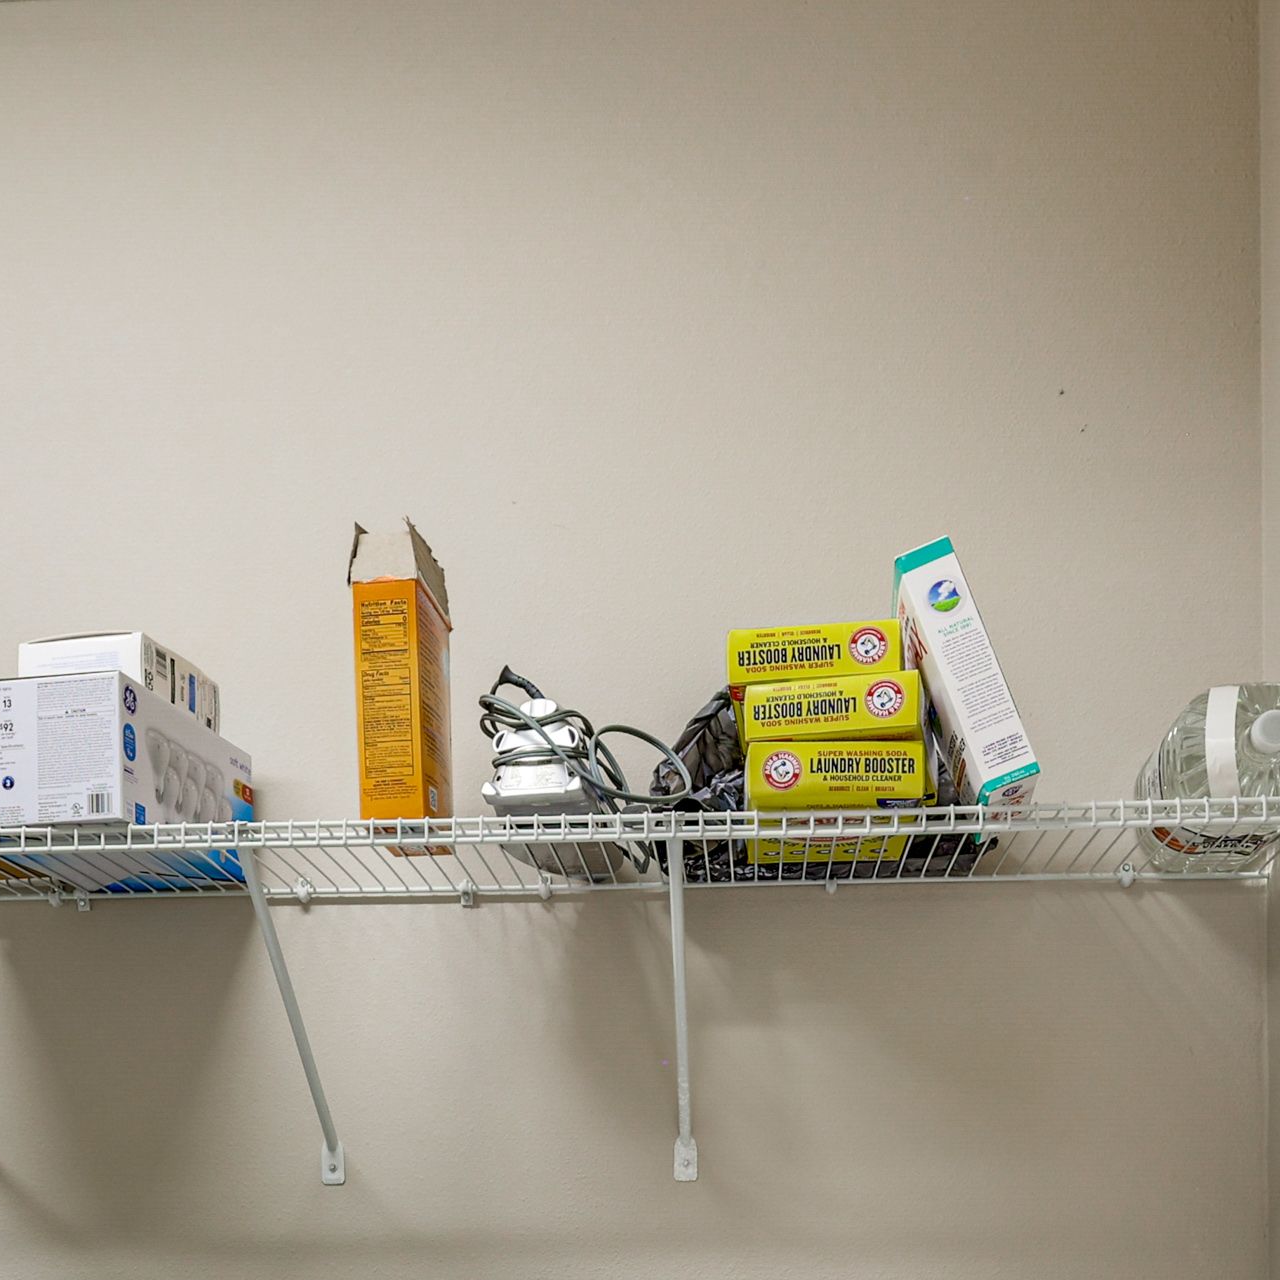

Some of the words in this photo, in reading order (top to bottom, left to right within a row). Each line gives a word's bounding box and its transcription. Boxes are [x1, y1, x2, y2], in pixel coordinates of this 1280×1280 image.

[750, 640, 779, 649] CLEANER
[781, 638, 821, 646] HOUSEHOLD
[738, 648, 787, 667] BOOSTER
[791, 644, 841, 663] LAUNDRY
[770, 663, 806, 672] WASHING
[808, 661, 834, 669] SUPER
[746, 666, 767, 674] SODA
[766, 694, 795, 703] CLEANER
[797, 691, 837, 700] HOUSEHOLD
[3, 699, 12, 708] 13
[806, 696, 857, 716] LAUNDRY
[754, 701, 802, 720] BOOSTER
[785, 717, 821, 726] WASHING
[824, 714, 850, 722] SUPER
[0, 723, 14, 732] $92
[761, 719, 782, 728] SODA
[810, 758, 861, 774] LAUNDRY
[865, 758, 915, 774] BOOSTER
